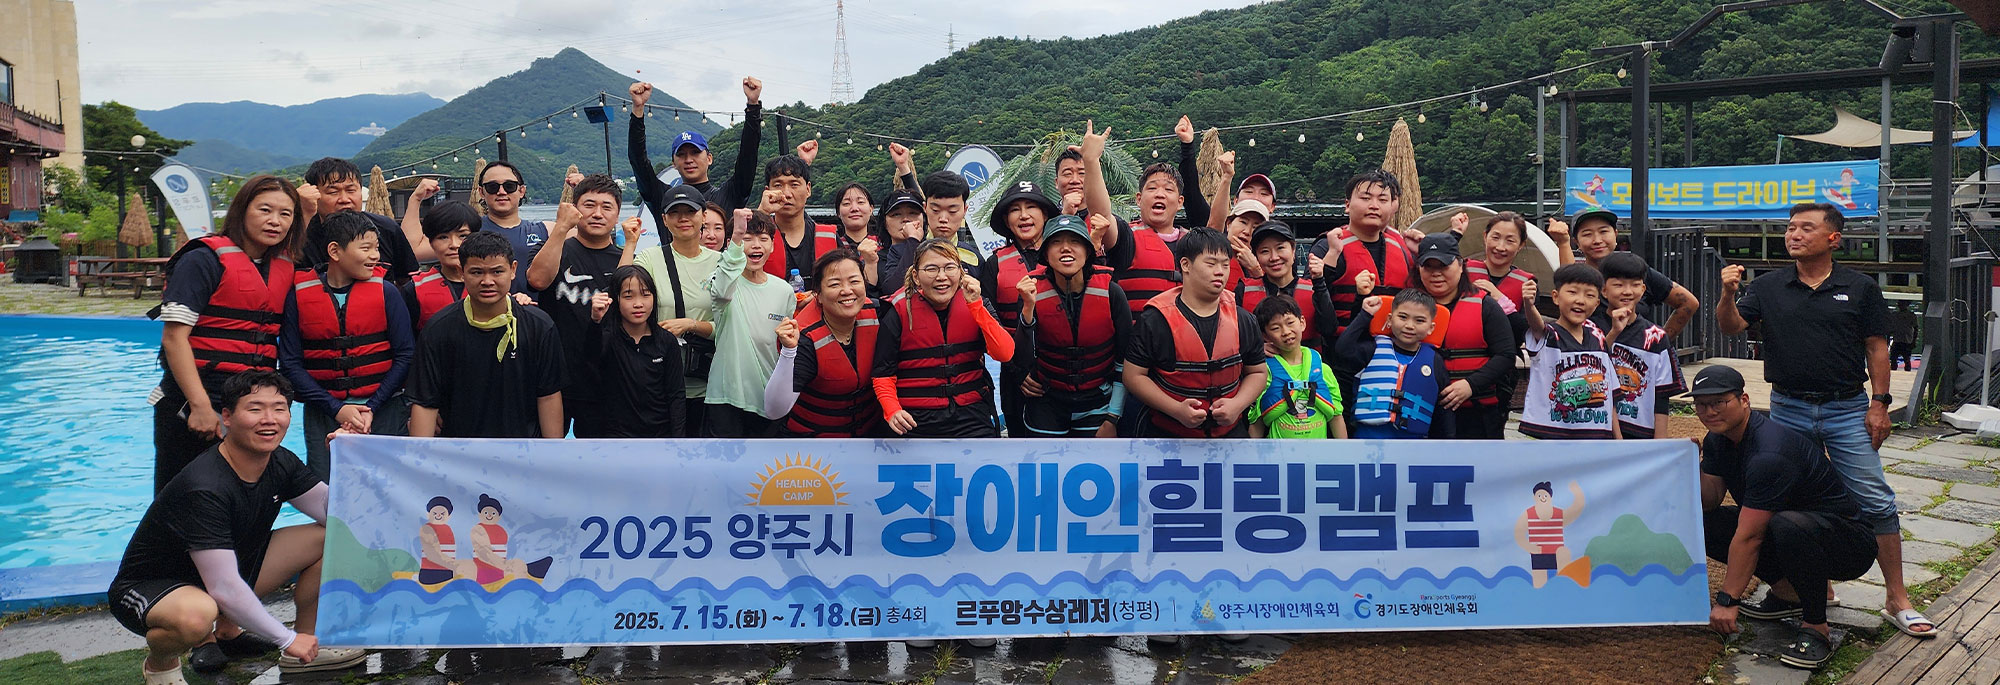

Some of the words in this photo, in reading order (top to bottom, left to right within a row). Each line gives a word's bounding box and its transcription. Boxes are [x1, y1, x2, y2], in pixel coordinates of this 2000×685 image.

[1713, 179, 1816, 206] 드라이브
[776, 479, 821, 489] HEALING
[783, 491, 814, 501] CAMP
[579, 515, 713, 560] 2025
[727, 513, 854, 560] 양주시
[613, 612, 664, 630] 2025.
[670, 605, 689, 630] 7.
[788, 603, 806, 628] 7.
[886, 606, 927, 624] 총4회
[1218, 602, 1340, 619] 양주시장애인체육회
[1375, 601, 1478, 617] 경기도장애인체육회
